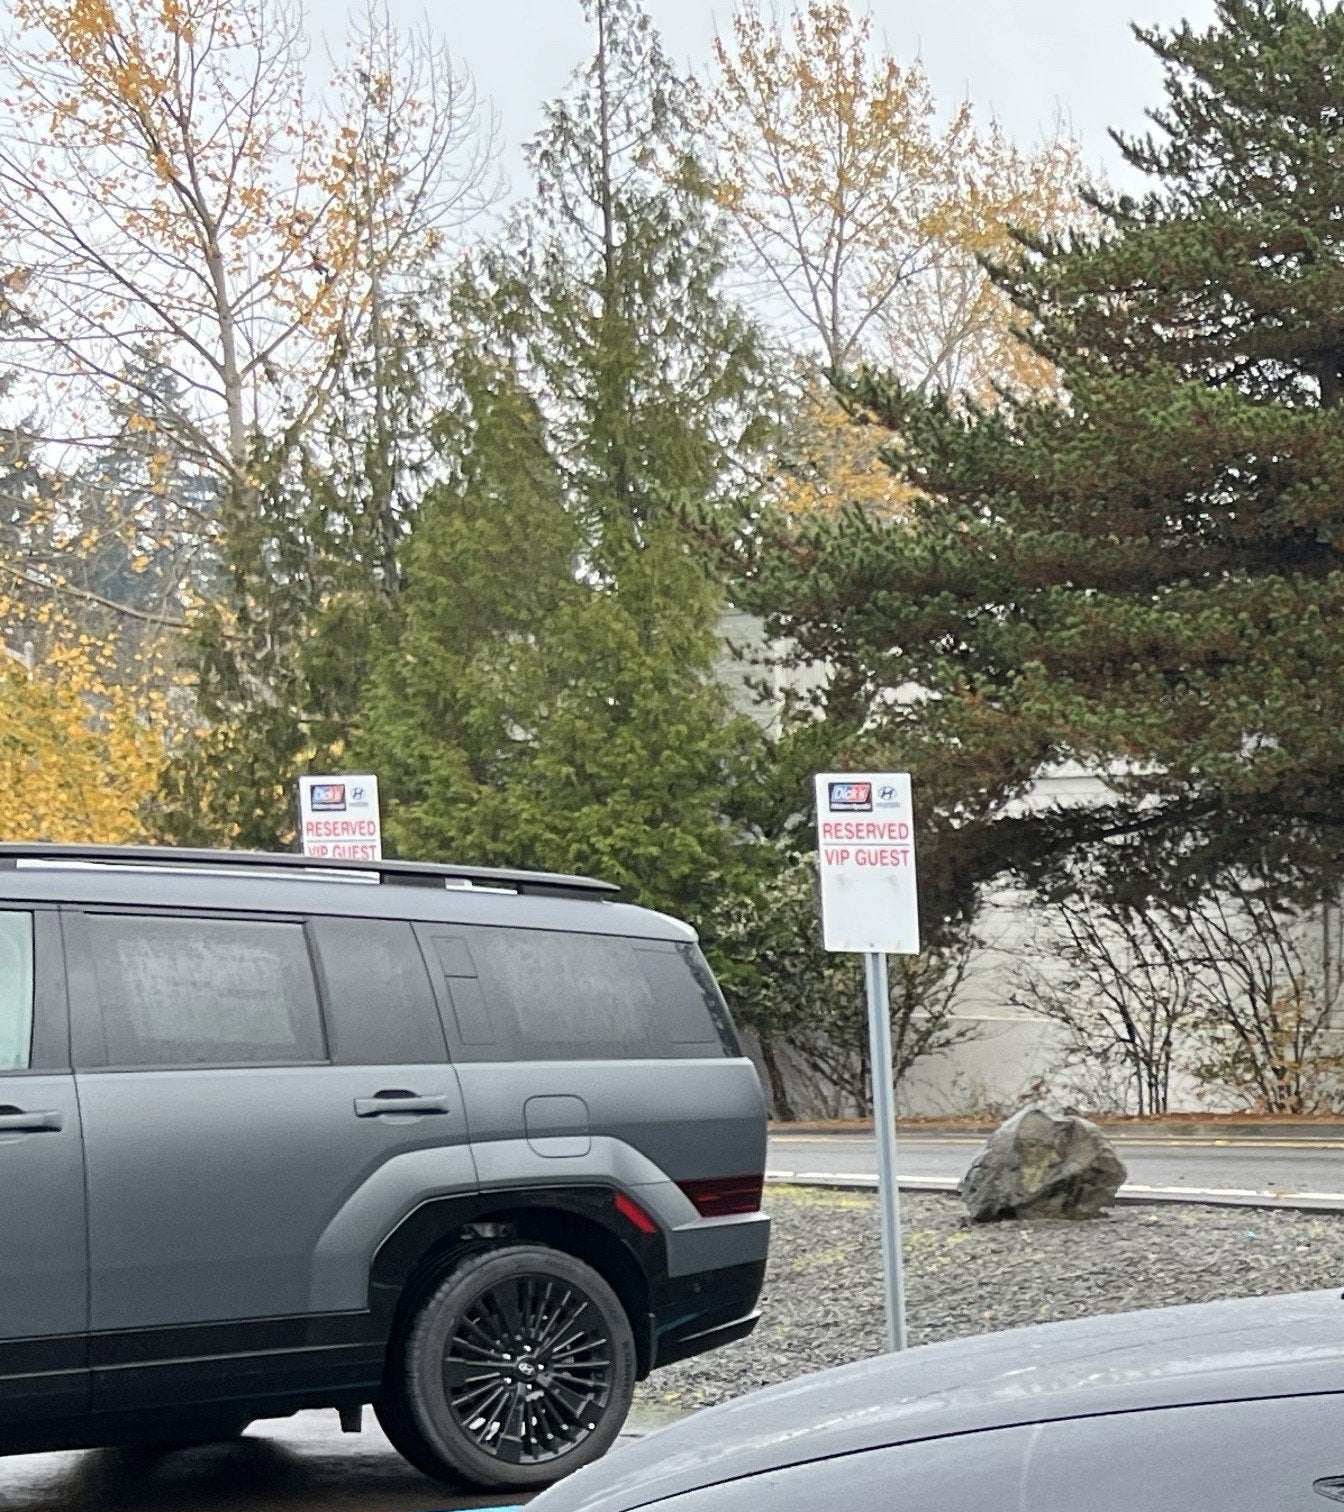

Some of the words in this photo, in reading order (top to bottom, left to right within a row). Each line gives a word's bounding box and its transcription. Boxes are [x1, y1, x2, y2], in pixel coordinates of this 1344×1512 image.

[306, 820, 376, 837] RESERVED
[823, 822, 909, 840] RESERVED
[825, 849, 850, 867] VIP
[855, 849, 910, 867] GUEST
